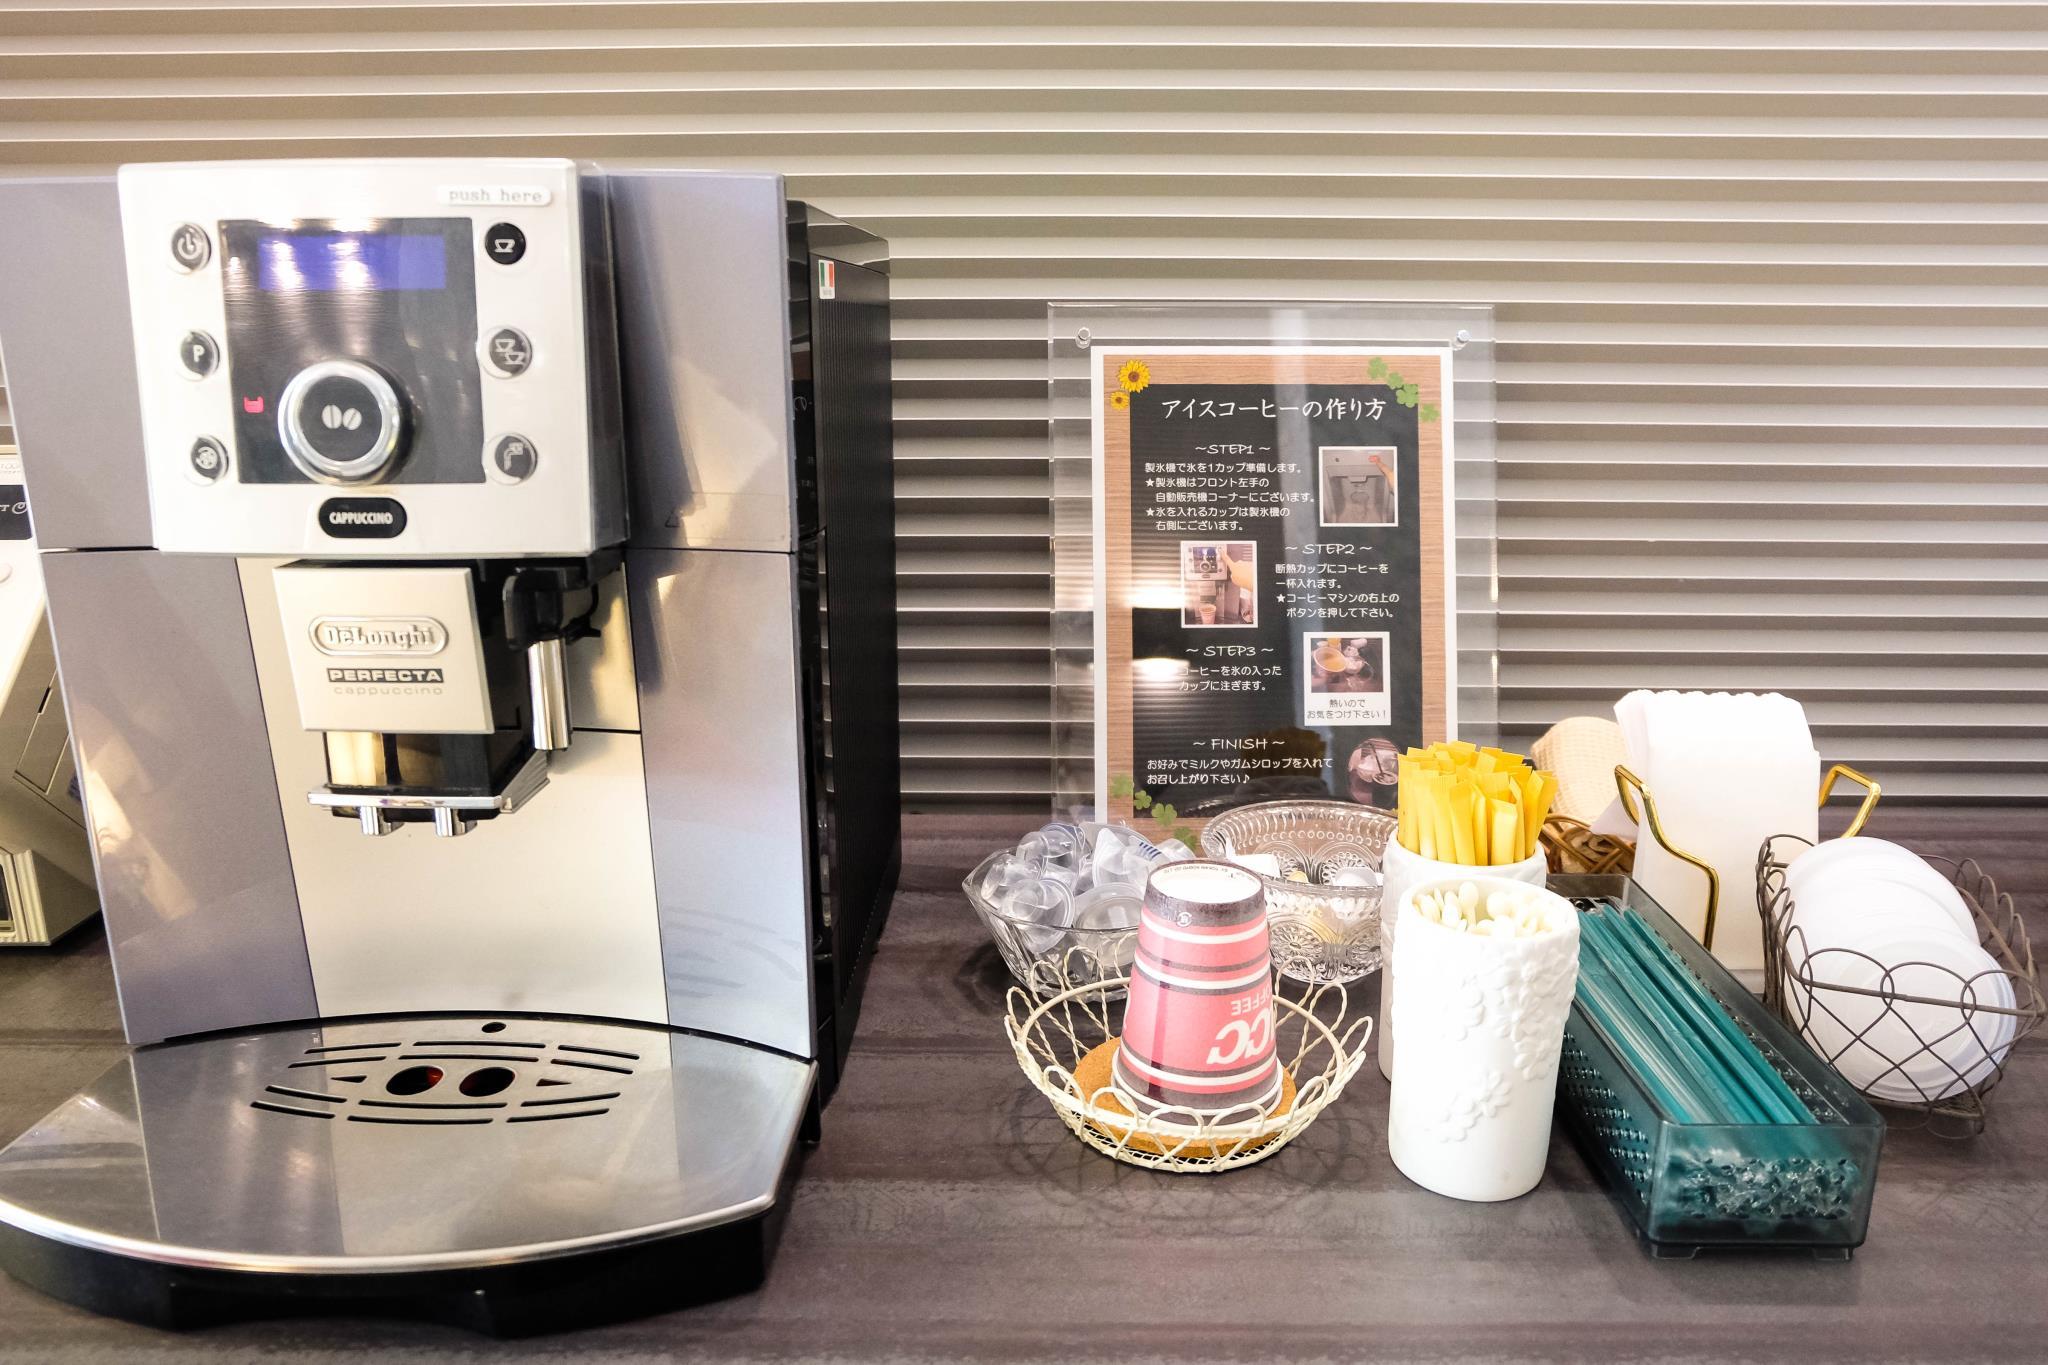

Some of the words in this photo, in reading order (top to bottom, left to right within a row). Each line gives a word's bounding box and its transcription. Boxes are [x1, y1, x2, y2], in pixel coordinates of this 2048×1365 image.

[449, 188, 490, 203] push
[500, 188, 542, 202] here
[193, 344, 205, 362] P
[1161, 398, 1387, 421] アイスコーヒーの作り方
[1144, 462, 1302, 474] 製氷機で氷を1カップ準備します。
[1155, 491, 1316, 503] 自動販売機コーナーにございます。
[329, 511, 393, 525] CAPPUCCINO
[1155, 520, 1244, 532] 右側にございます。
[1275, 563, 1389, 574] 断熱カップにコーヒーを
[1275, 578, 1343, 590] 一杯入れます。
[1286, 607, 1394, 618] ボタンを押して下さい。
[329, 669, 442, 682] PERFECTA
[333, 686, 443, 696] cappuccino
[1178, 680, 1267, 691] カップに注ぎます。
[1329, 698, 1366, 708] 熱いので
[1147, 757, 1333, 770] お好みでミルクやガムシロップを入れて
